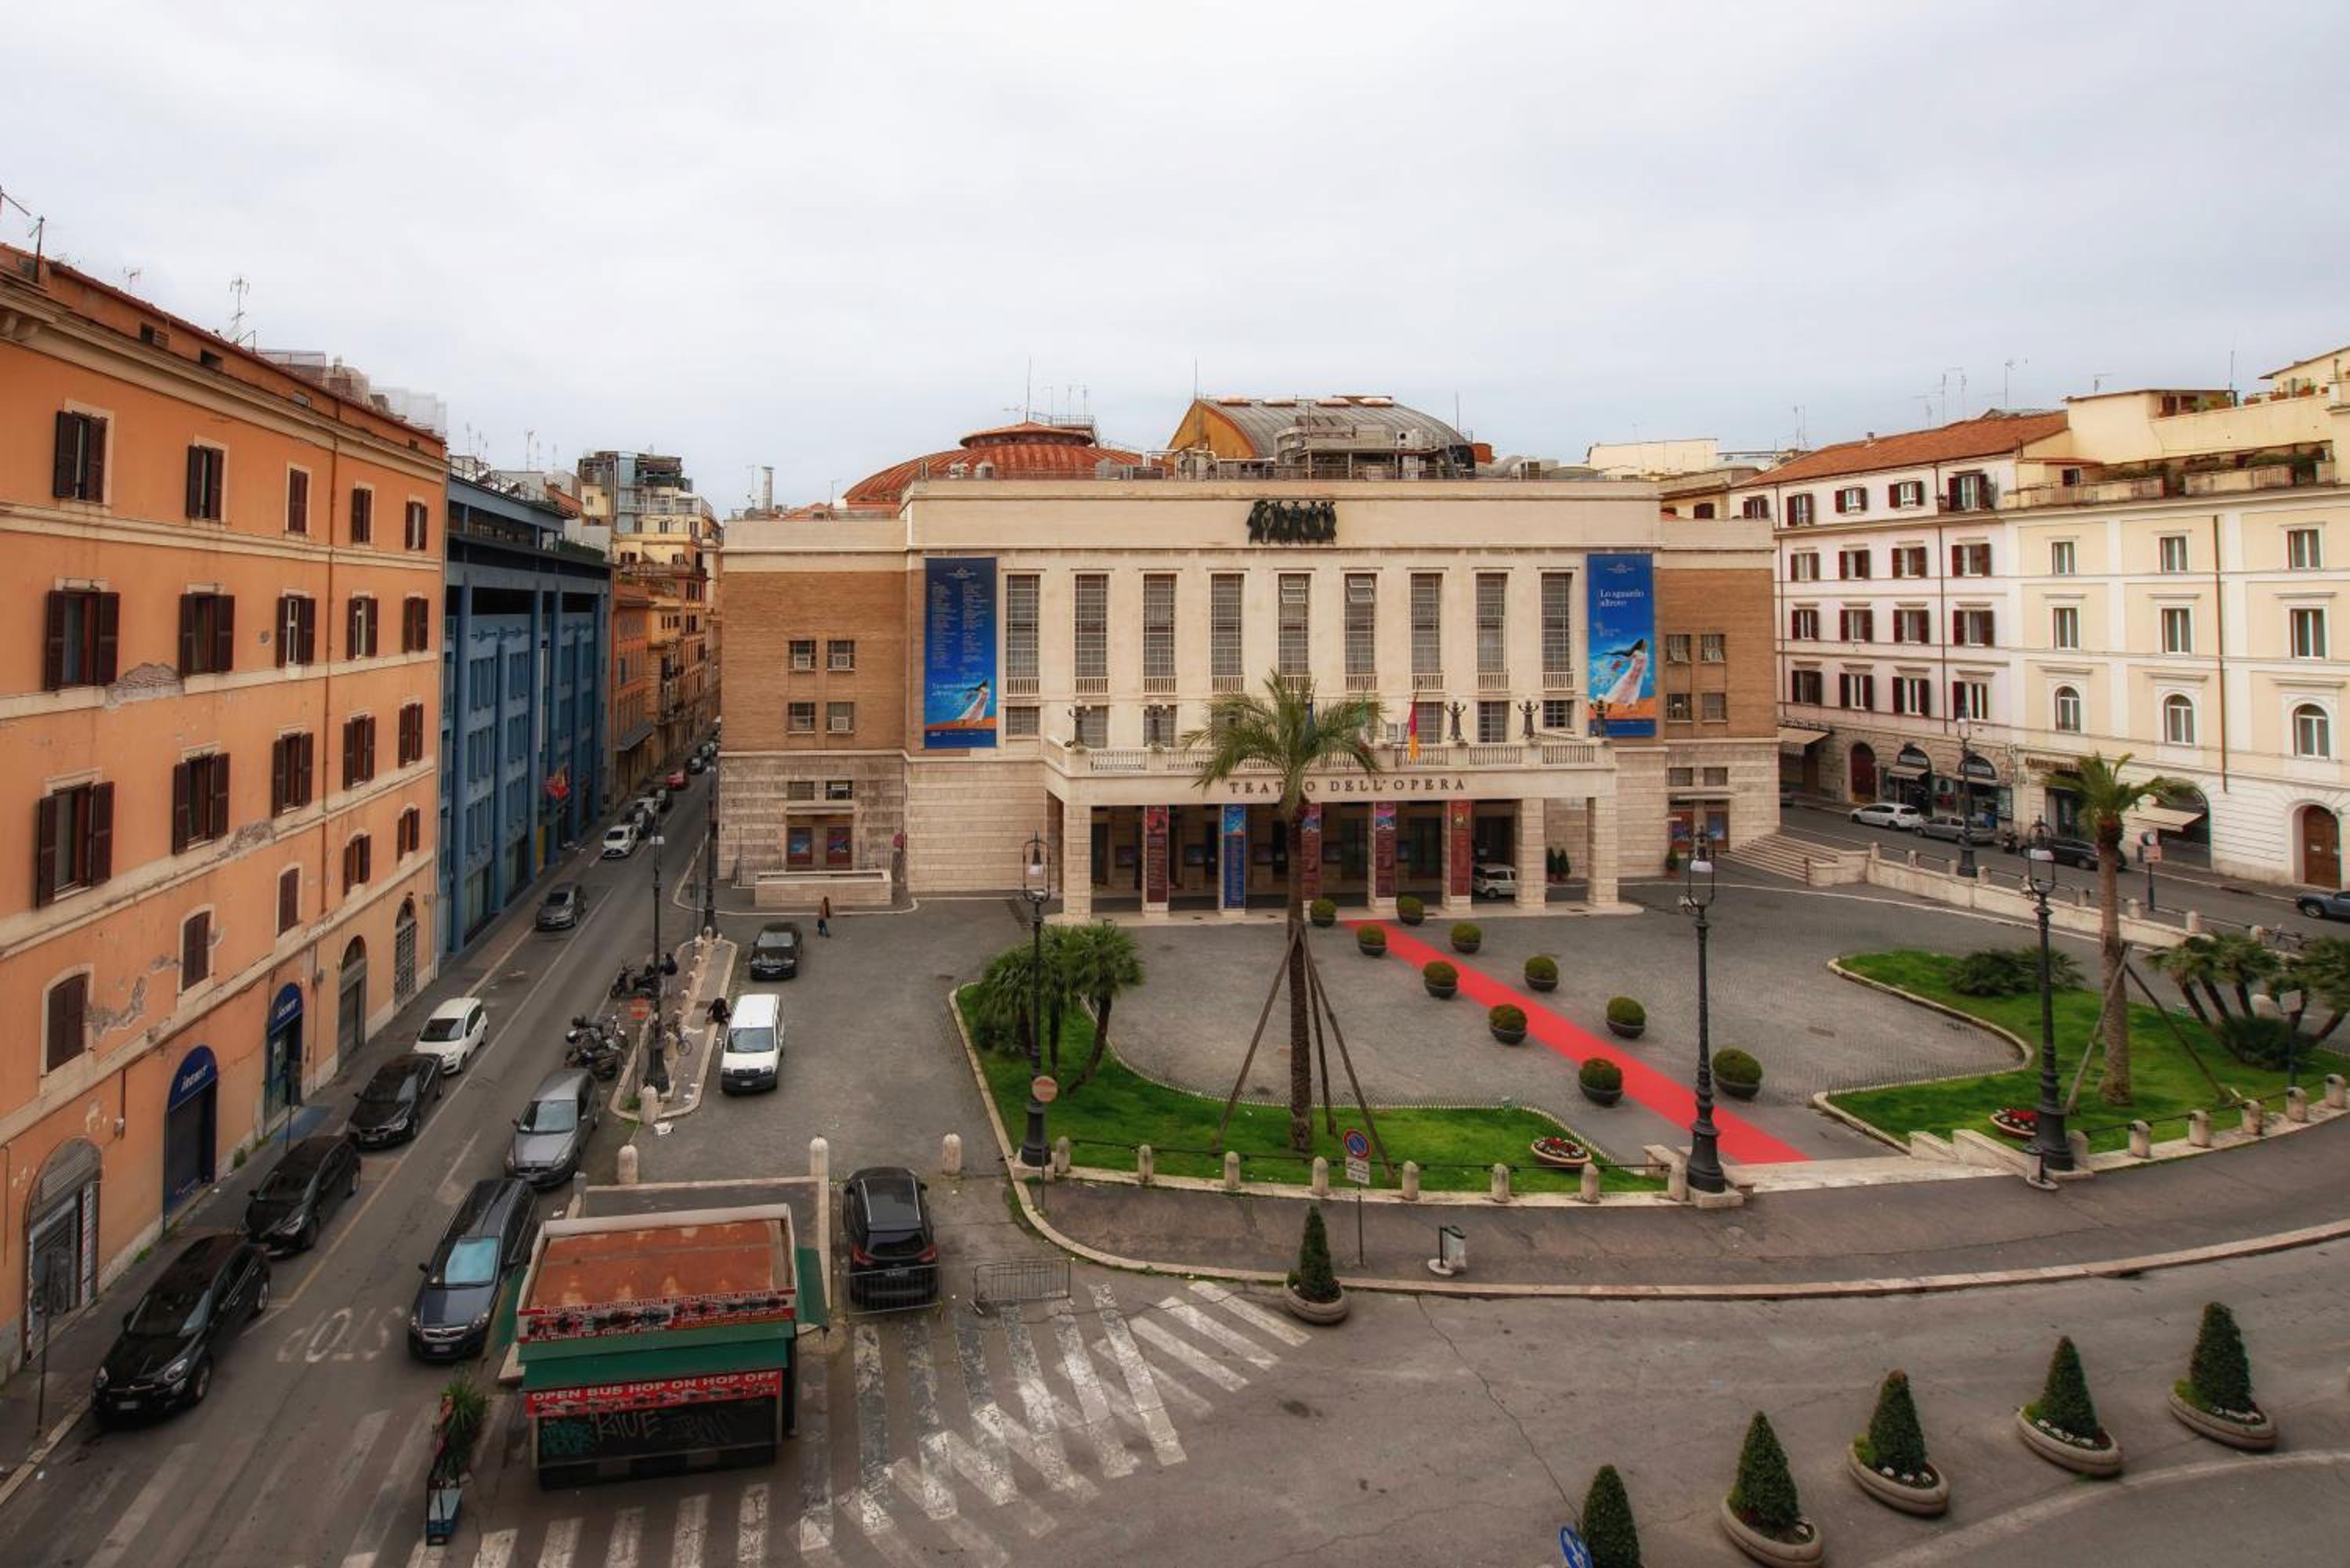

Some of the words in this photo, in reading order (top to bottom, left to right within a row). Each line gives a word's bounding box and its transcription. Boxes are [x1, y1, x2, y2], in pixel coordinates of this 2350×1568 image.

[1229, 781, 1316, 793] TEATO
[532, 1389, 580, 1402] OPEN
[587, 1386, 623, 1396] BUS
[629, 1382, 665, 1393] HOP
[671, 1379, 696, 1389] ON
[702, 1375, 739, 1386] HOP
[745, 1371, 778, 1382] OFF
